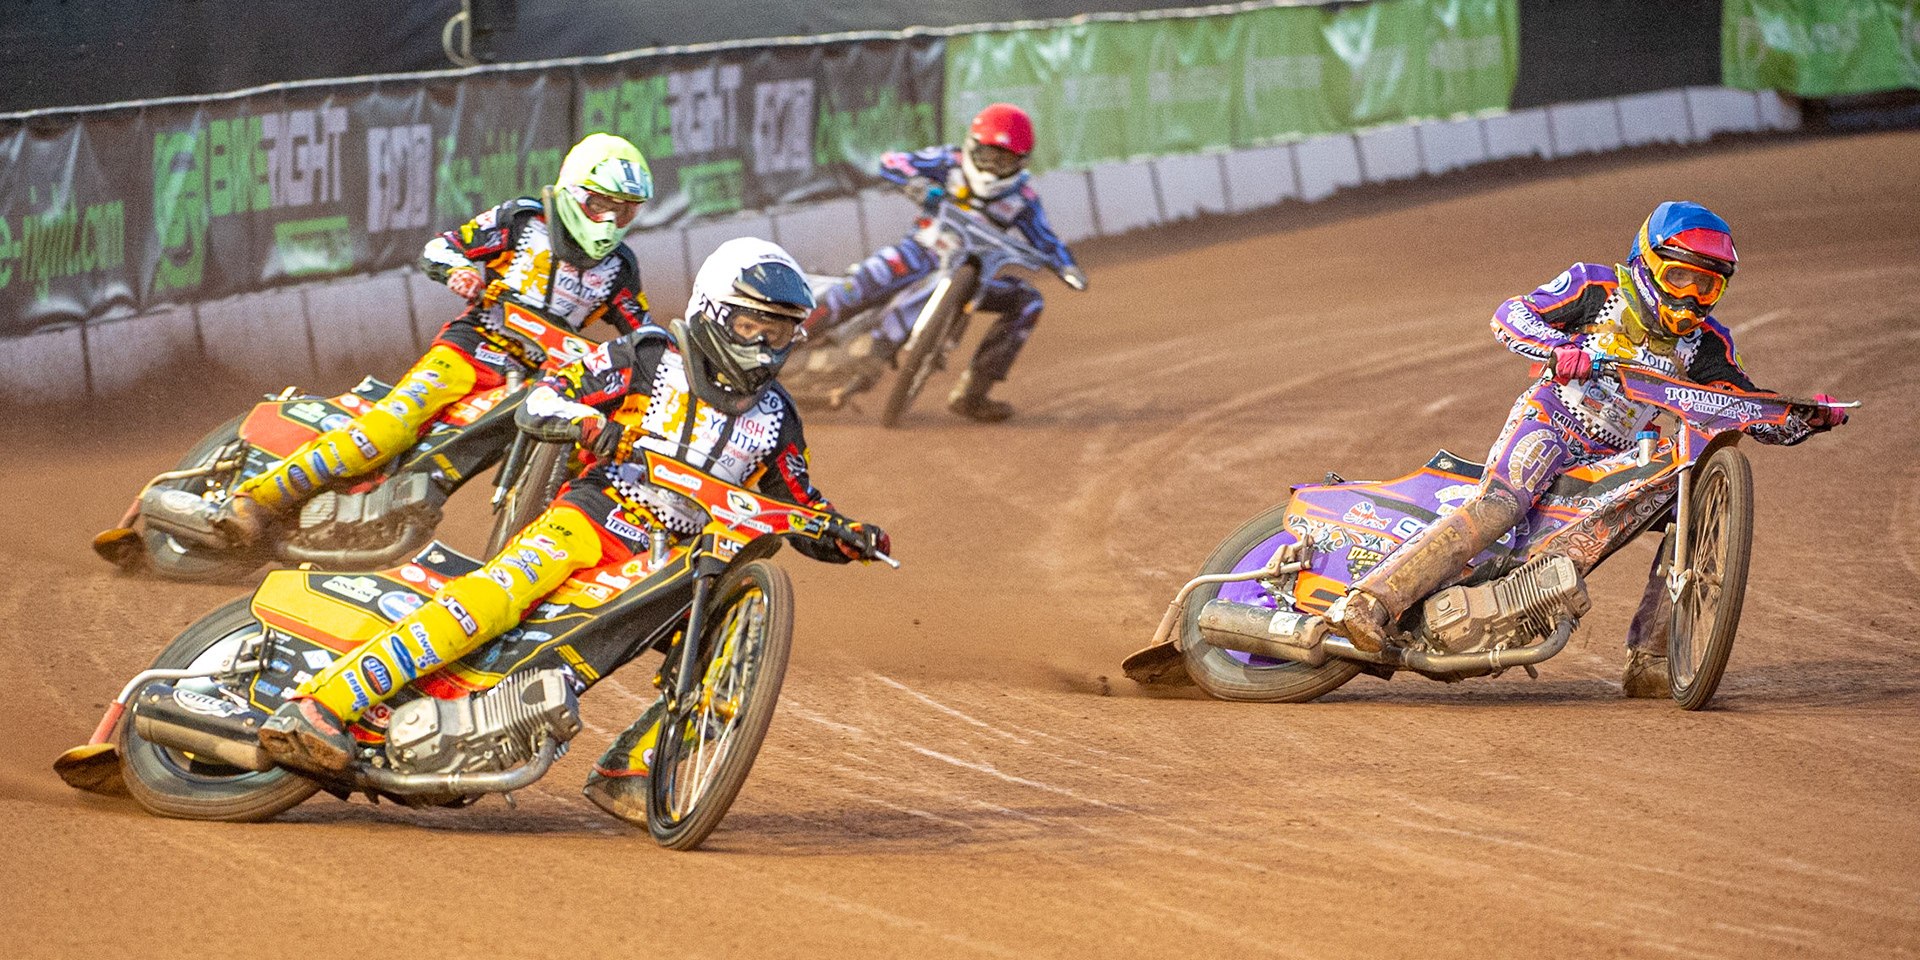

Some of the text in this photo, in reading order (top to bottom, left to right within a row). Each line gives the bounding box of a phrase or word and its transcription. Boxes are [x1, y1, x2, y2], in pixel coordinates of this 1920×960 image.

[1665, 387, 1763, 419] TOMAHAWK
[718, 538, 744, 554] JC
[439, 595, 480, 638] JCB
